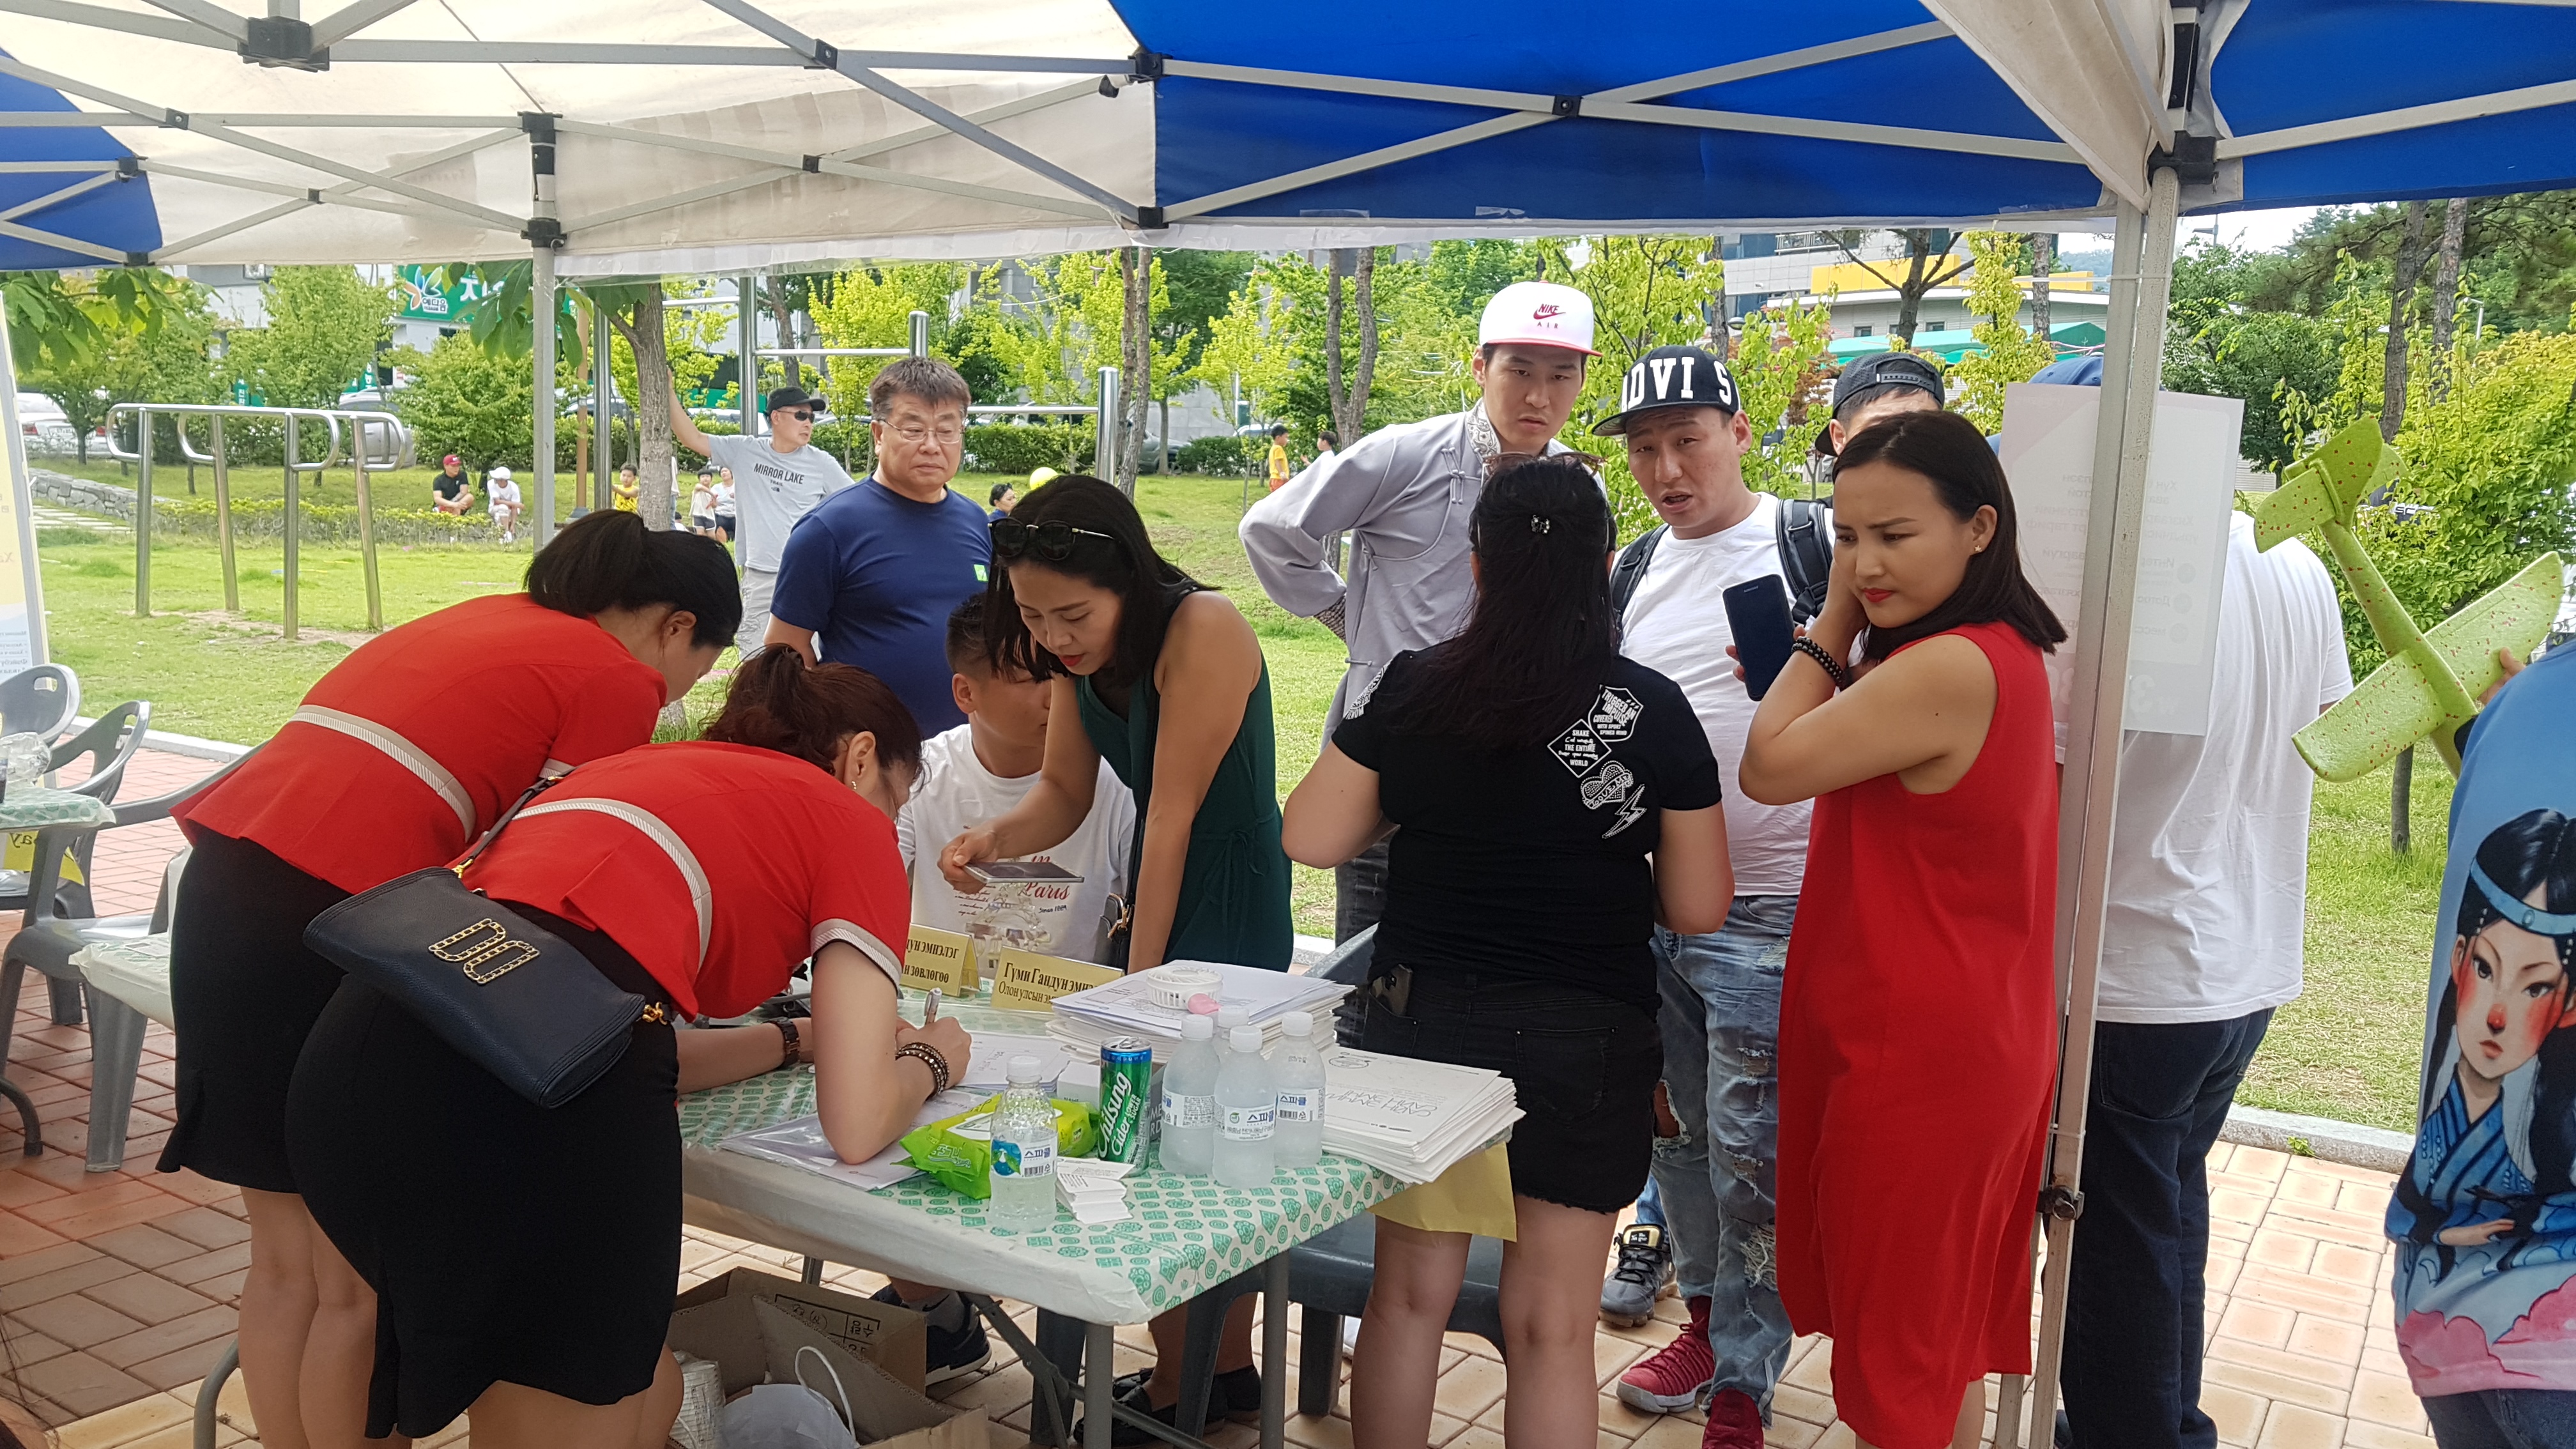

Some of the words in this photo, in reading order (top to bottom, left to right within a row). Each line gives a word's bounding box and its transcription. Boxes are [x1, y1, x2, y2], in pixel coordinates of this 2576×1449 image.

[1538, 303, 1560, 314] NIKE
[754, 463, 783, 480] MIRROR
[784, 471, 804, 484] LAKE
[999, 981, 1019, 997] Олон
[1018, 988, 1043, 1002] улсын
[1031, 968, 1068, 992] Гандун
[1125, 1094, 1138, 1117] LOWER
[1130, 1097, 1142, 1120] SUGAR
[1111, 1116, 1131, 1156] Cider
